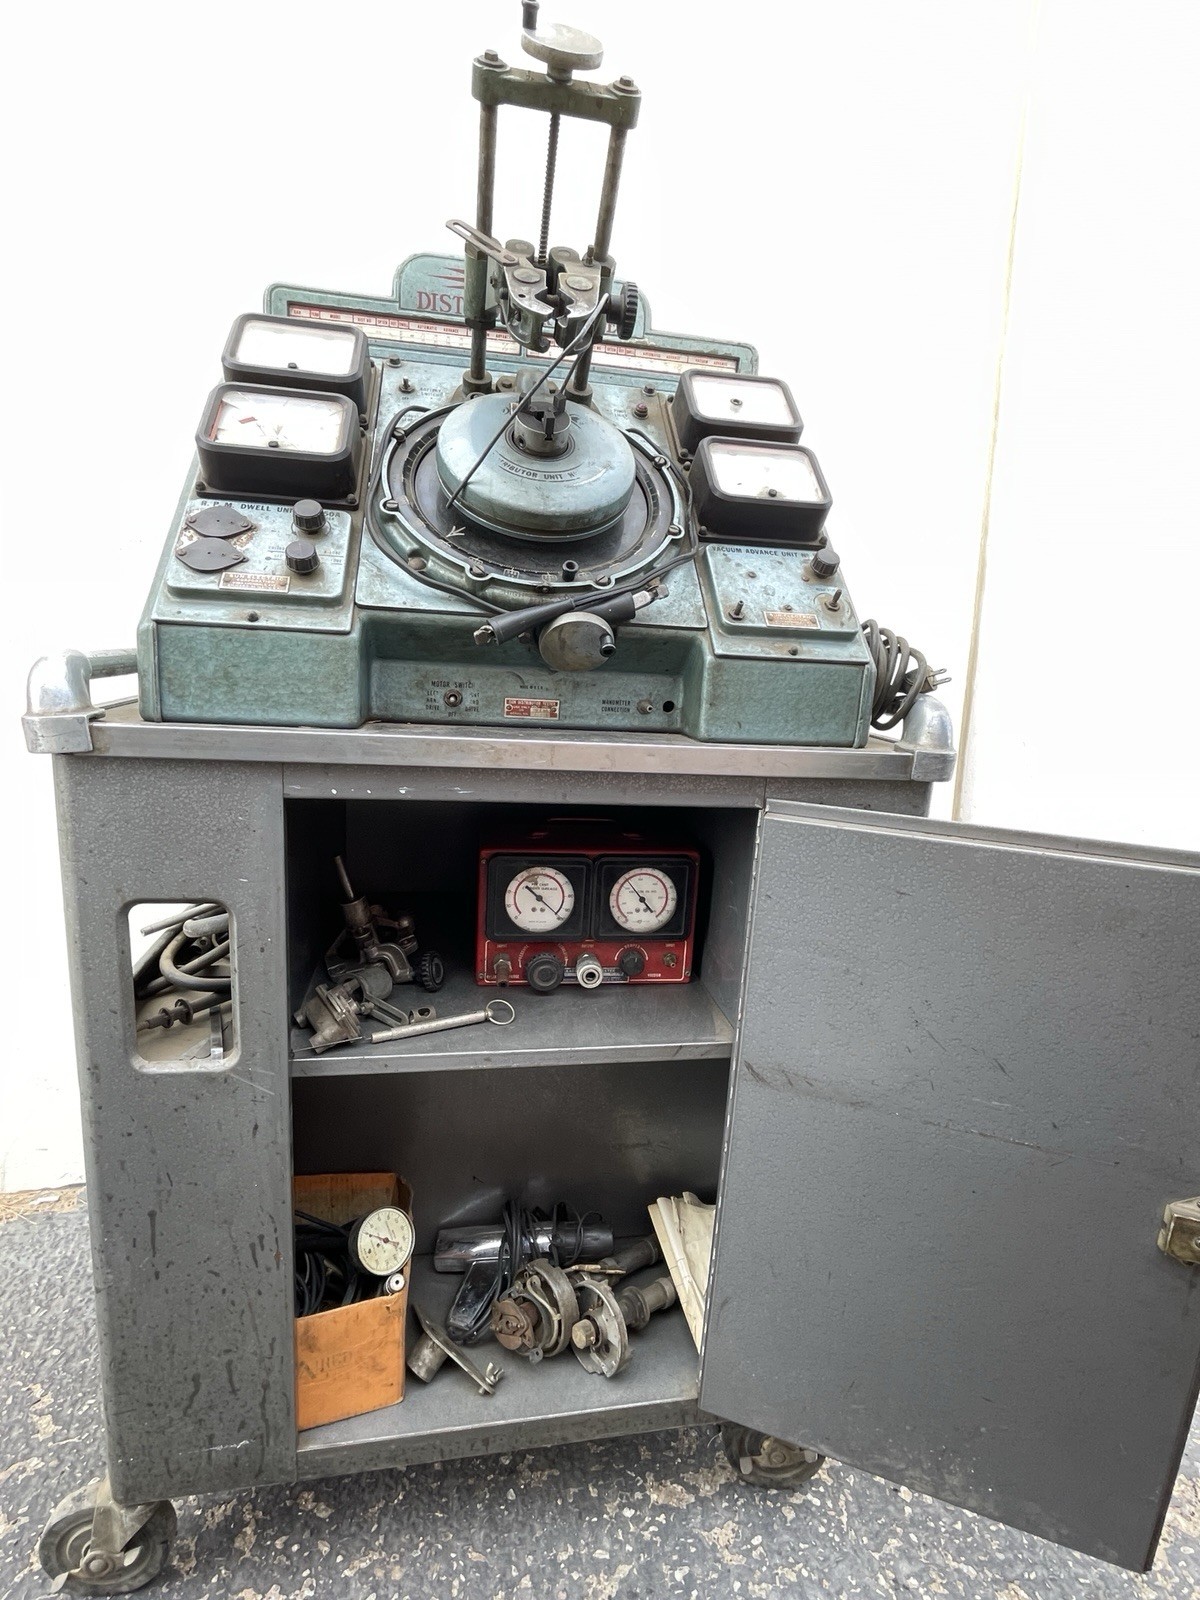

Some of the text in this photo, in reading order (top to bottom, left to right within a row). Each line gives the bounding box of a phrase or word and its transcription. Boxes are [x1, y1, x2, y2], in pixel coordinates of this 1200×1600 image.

[416, 291, 464, 315] DIST
[241, 503, 272, 512] DWELL
[712, 546, 742, 554] VACUUM
[745, 548, 779, 557] ADVANCE
[431, 680, 450, 688] MOTOR
